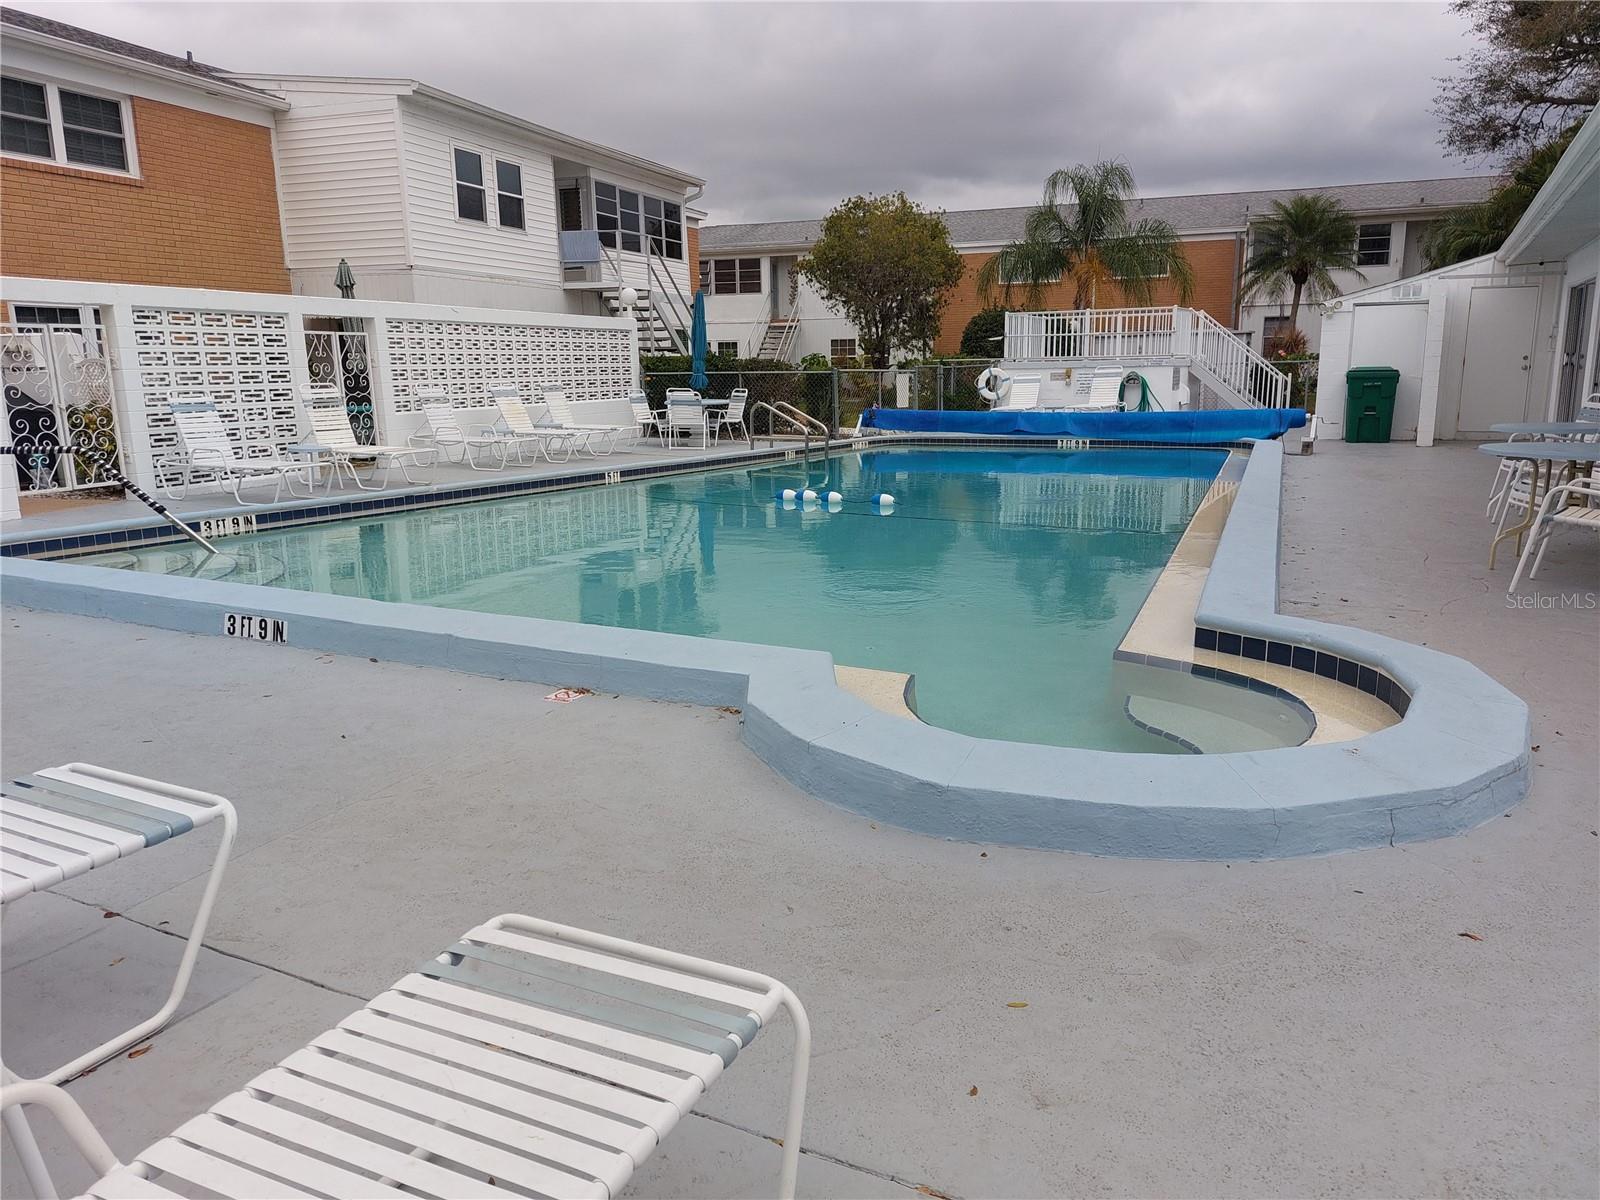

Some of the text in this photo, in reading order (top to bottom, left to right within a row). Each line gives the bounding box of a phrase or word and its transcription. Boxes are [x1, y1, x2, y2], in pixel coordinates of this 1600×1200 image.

[216, 518, 227, 534] FT
[227, 614, 286, 643] 3 FT. 9 IN.
